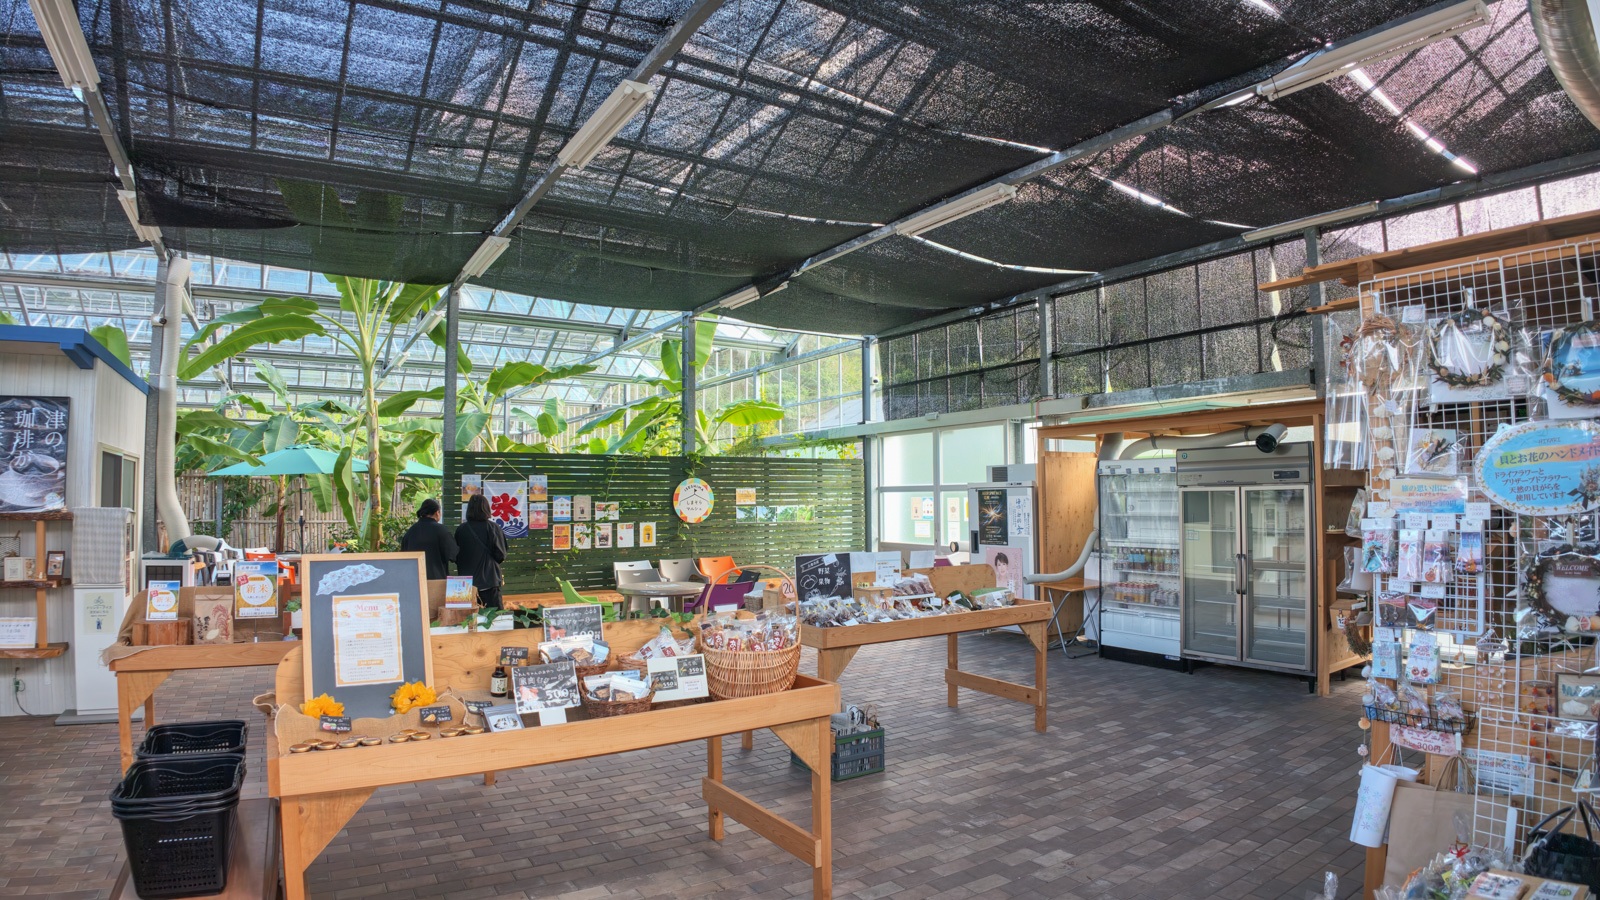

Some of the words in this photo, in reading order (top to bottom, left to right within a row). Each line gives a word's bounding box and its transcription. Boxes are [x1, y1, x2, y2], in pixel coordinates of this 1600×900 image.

[45, 410, 66, 449] 津の
[14, 410, 35, 470] 珈琲が
[1495, 468, 1545, 480] ドライフラワーと
[1509, 483, 1560, 495] 天然の貝がらを
[1516, 492, 1566, 502] 使用しています
[491, 492, 521, 522] 氷
[246, 584, 269, 594] 新米
[355, 604, 379, 612] Menu
[1417, 742, 1442, 754] 300円
